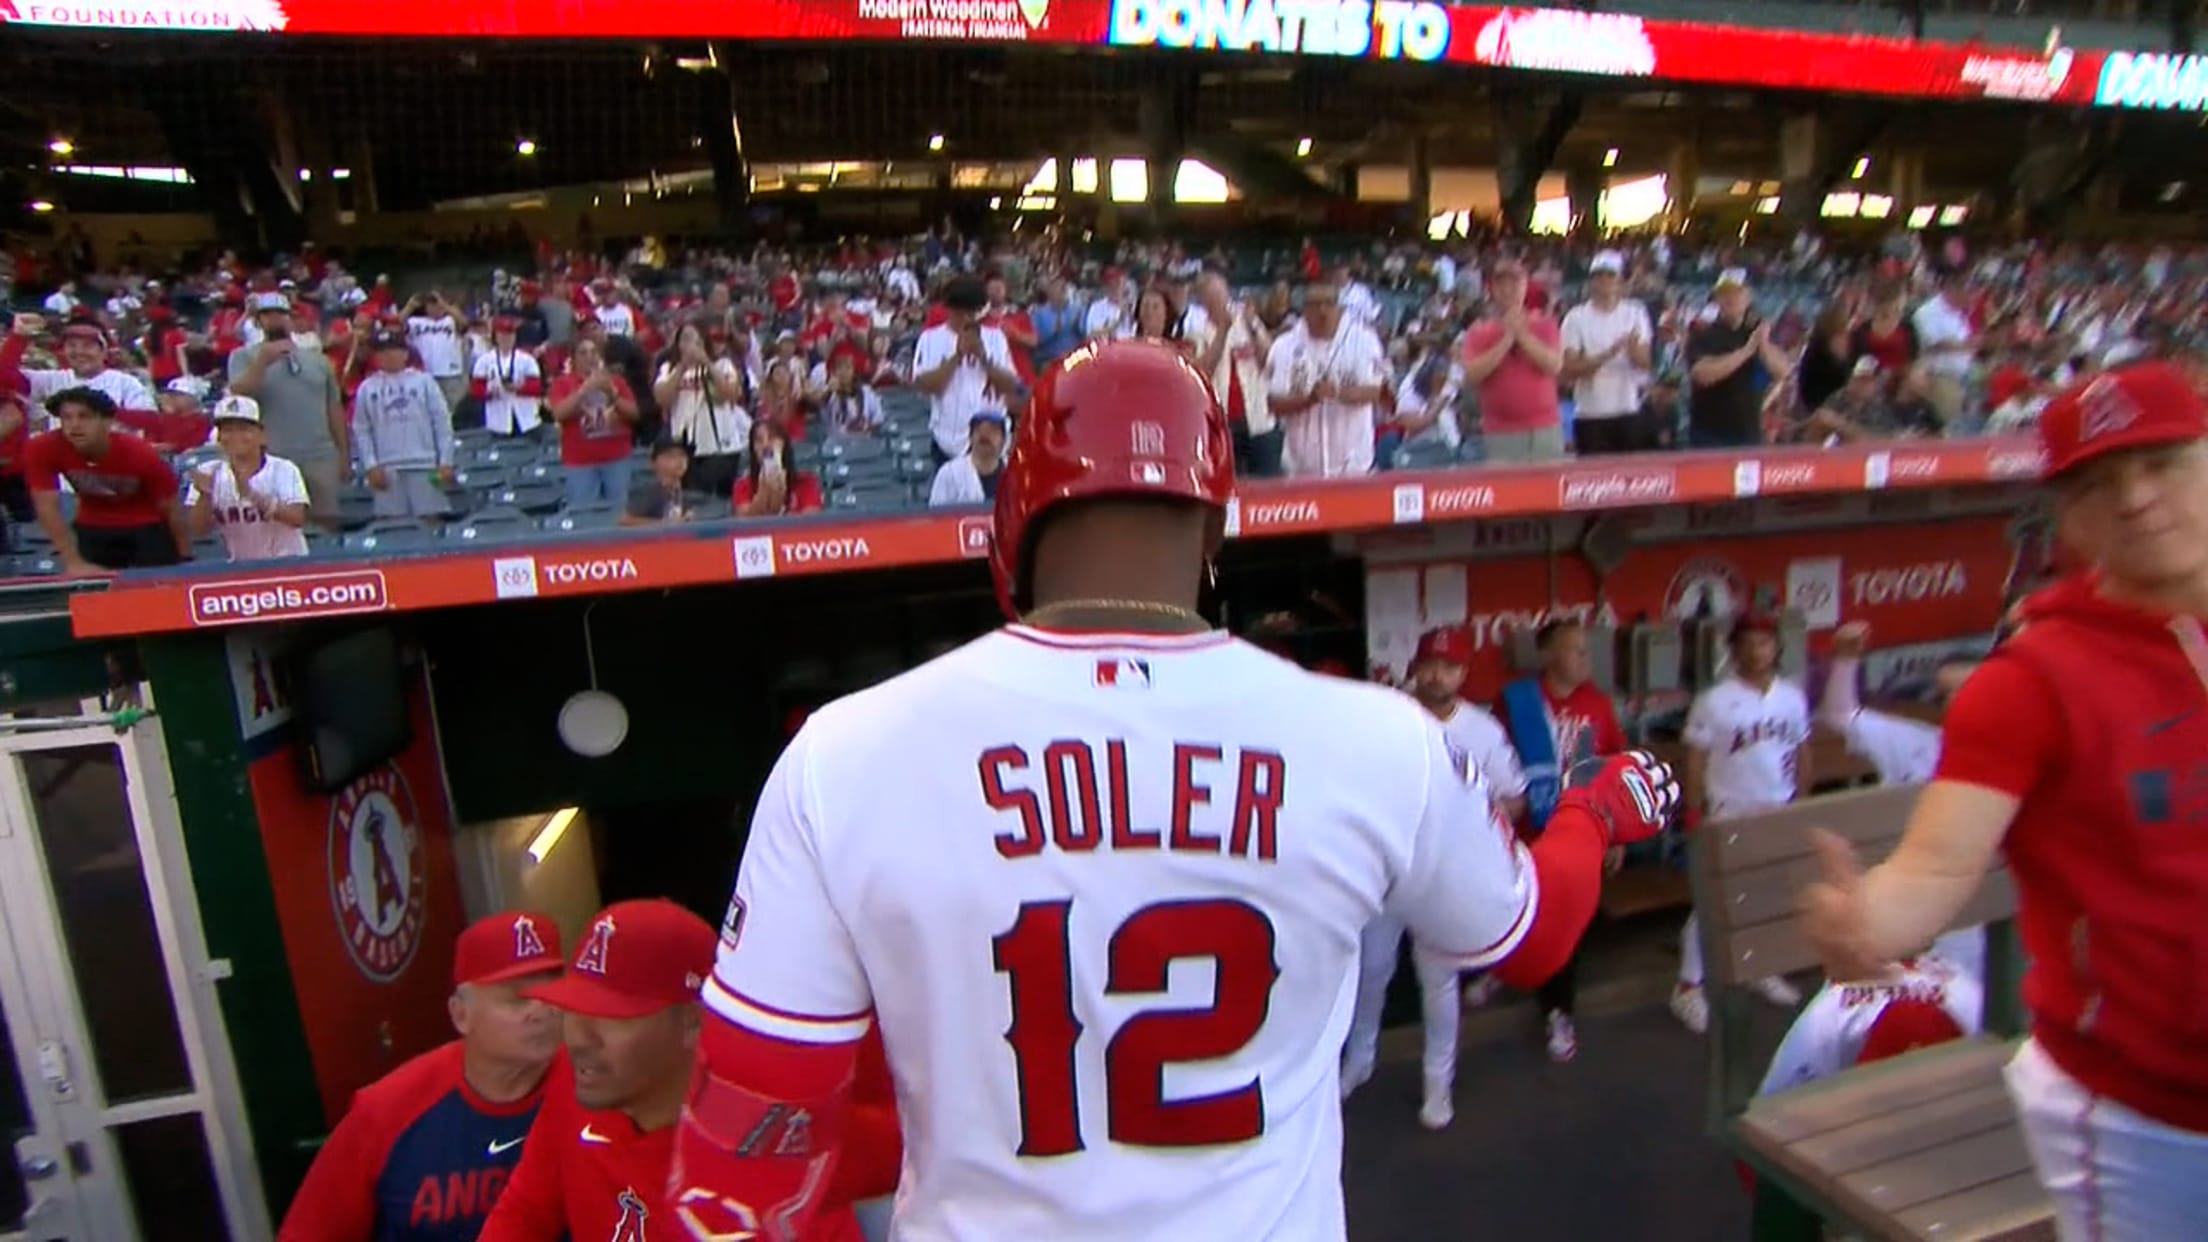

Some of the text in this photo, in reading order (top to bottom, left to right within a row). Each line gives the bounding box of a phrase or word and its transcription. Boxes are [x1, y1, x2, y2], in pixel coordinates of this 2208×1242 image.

[31, 6, 230, 27] FOUNDATION
[859, 0, 928, 18] Modern
[902, 19, 1027, 39] FRATERNAL FINANCIAL
[1109, 0, 1371, 56] DONATES
[1374, 1, 1449, 61] TO
[1247, 499, 1320, 524] TOYOTA
[1430, 486, 1495, 511] TOYOTA
[781, 538, 870, 563] TOYOTA
[544, 557, 638, 584] TOYOTA
[1851, 560, 1967, 607] TOYOTA
[202, 581, 376, 616] angels.com
[977, 738, 1286, 864] SOLER
[991, 895, 1282, 1157] 12
